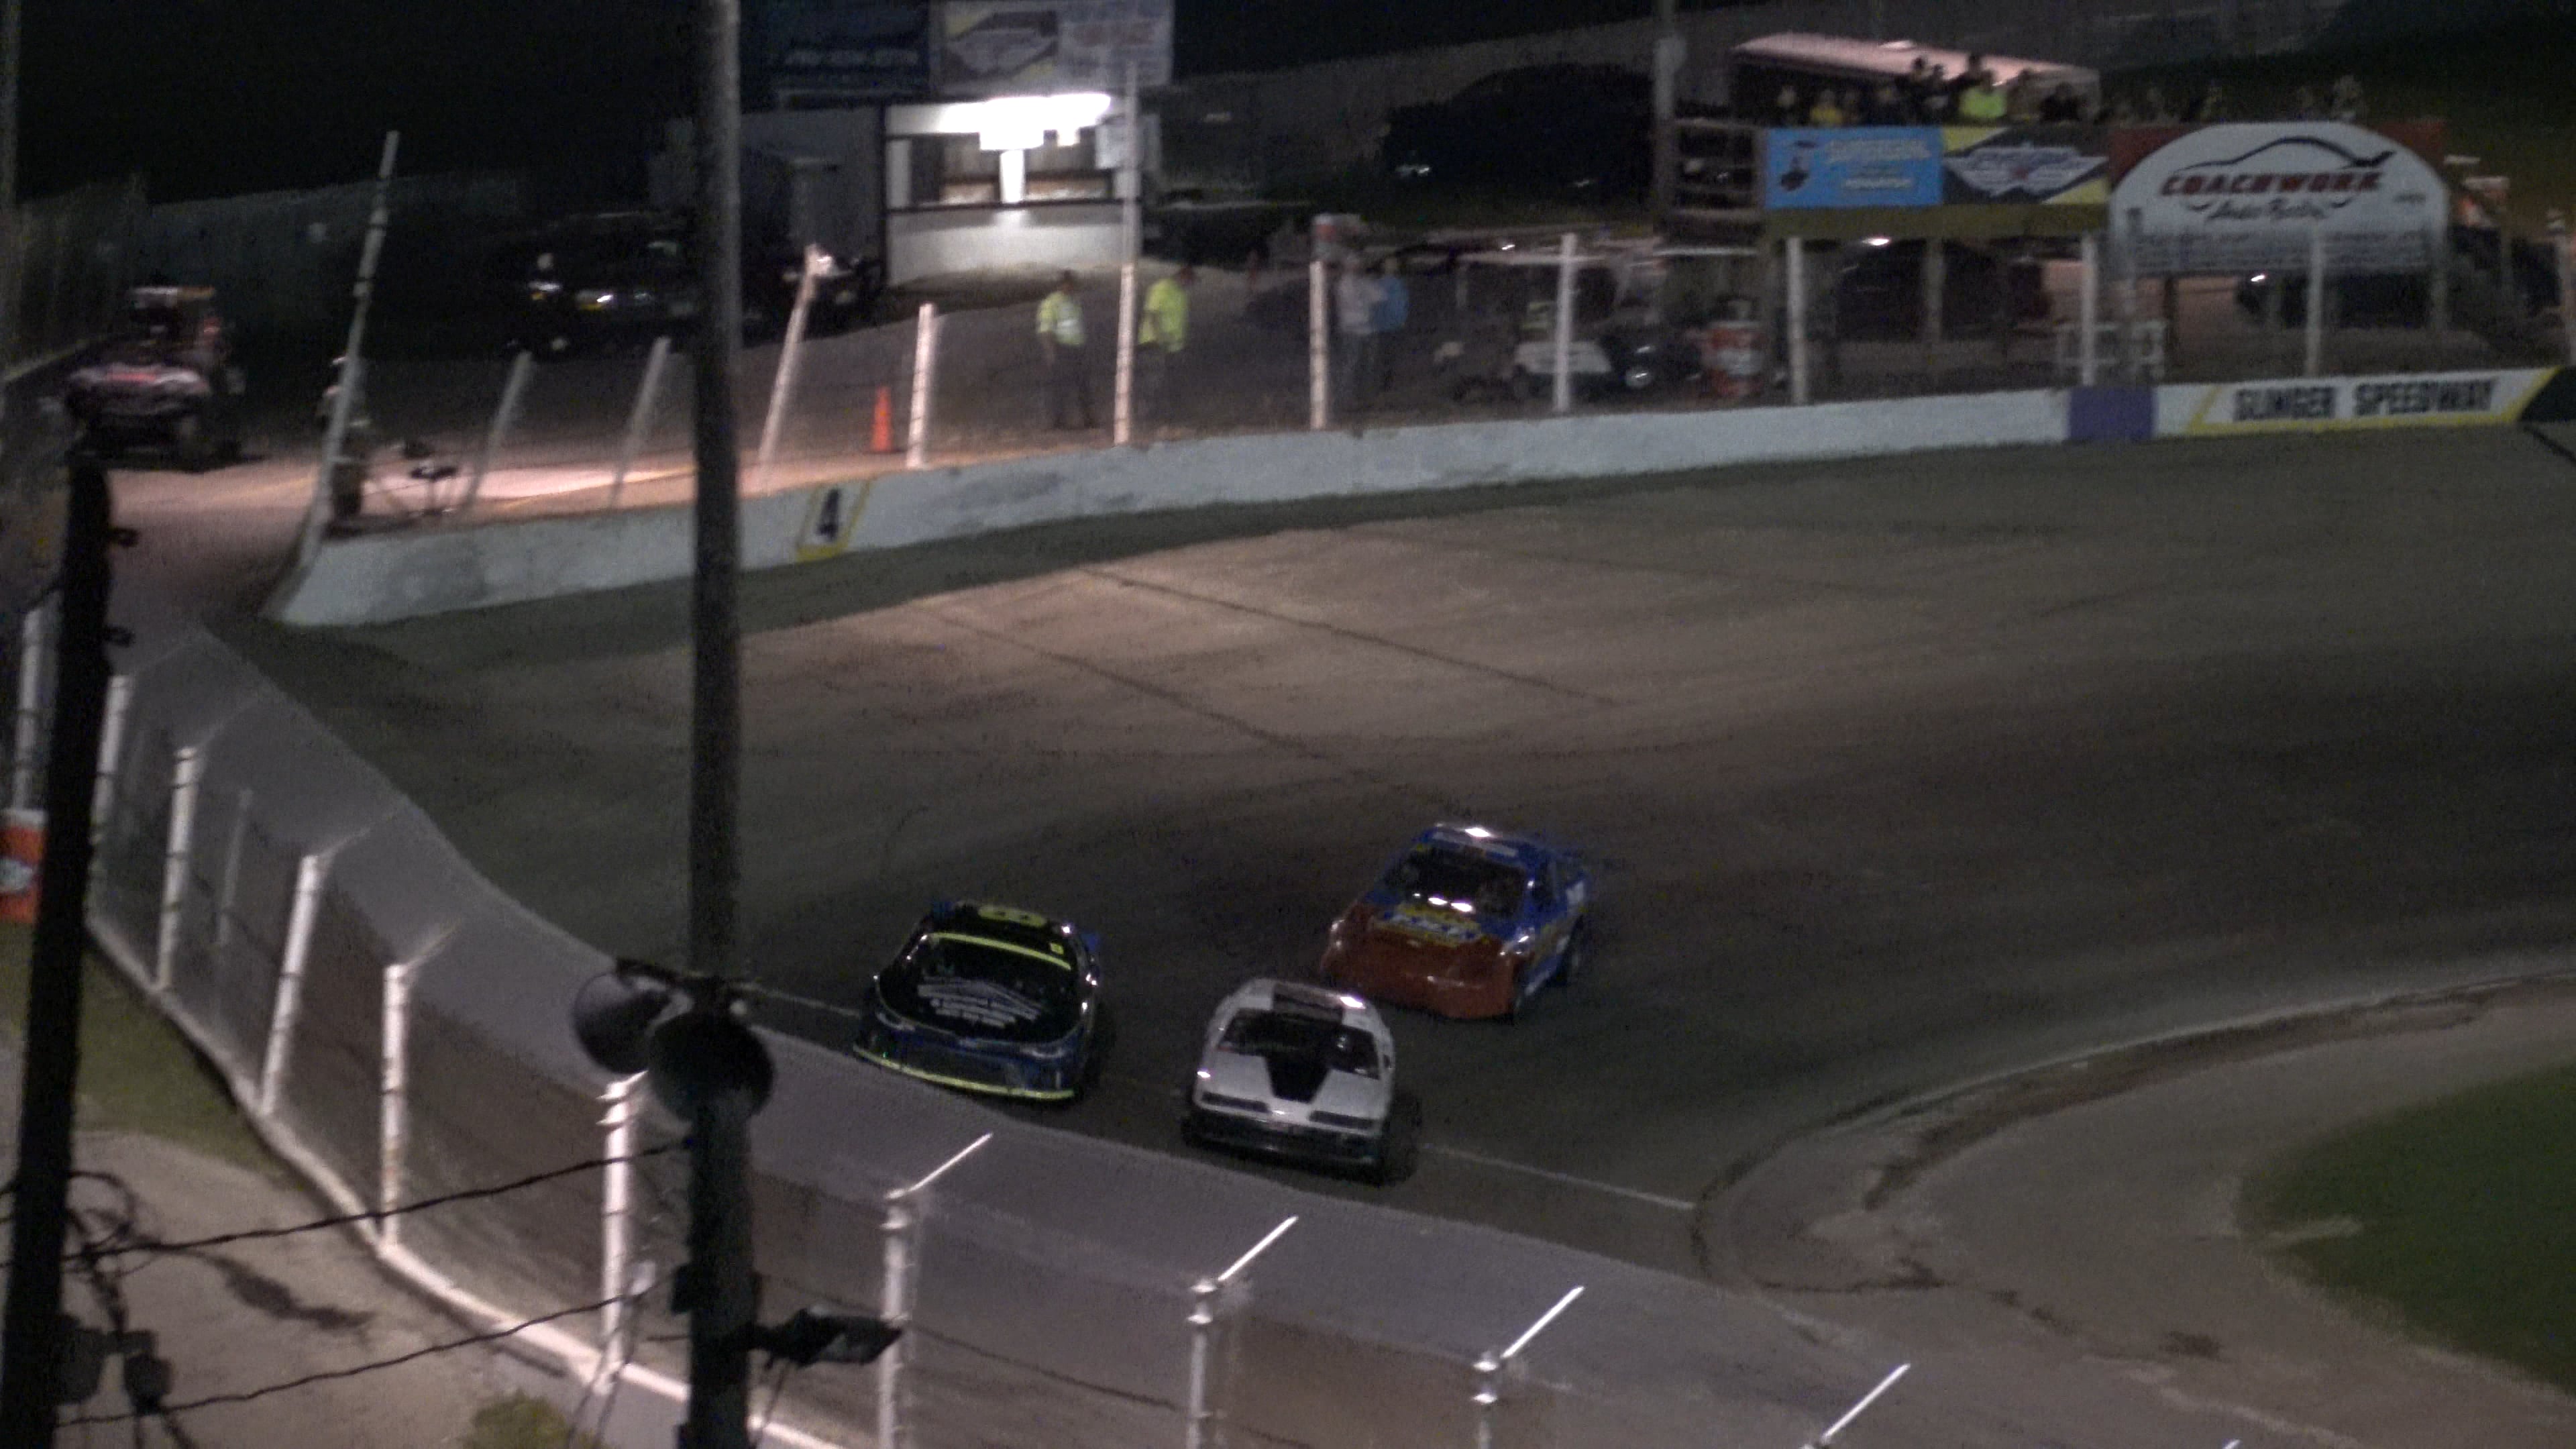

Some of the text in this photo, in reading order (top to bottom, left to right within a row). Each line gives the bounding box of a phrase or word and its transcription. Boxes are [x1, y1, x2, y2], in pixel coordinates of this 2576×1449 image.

[2160, 171, 2384, 197] COACHWORK
[2353, 378, 2497, 417] SPEEDWAY
[816, 488, 842, 541] 4
